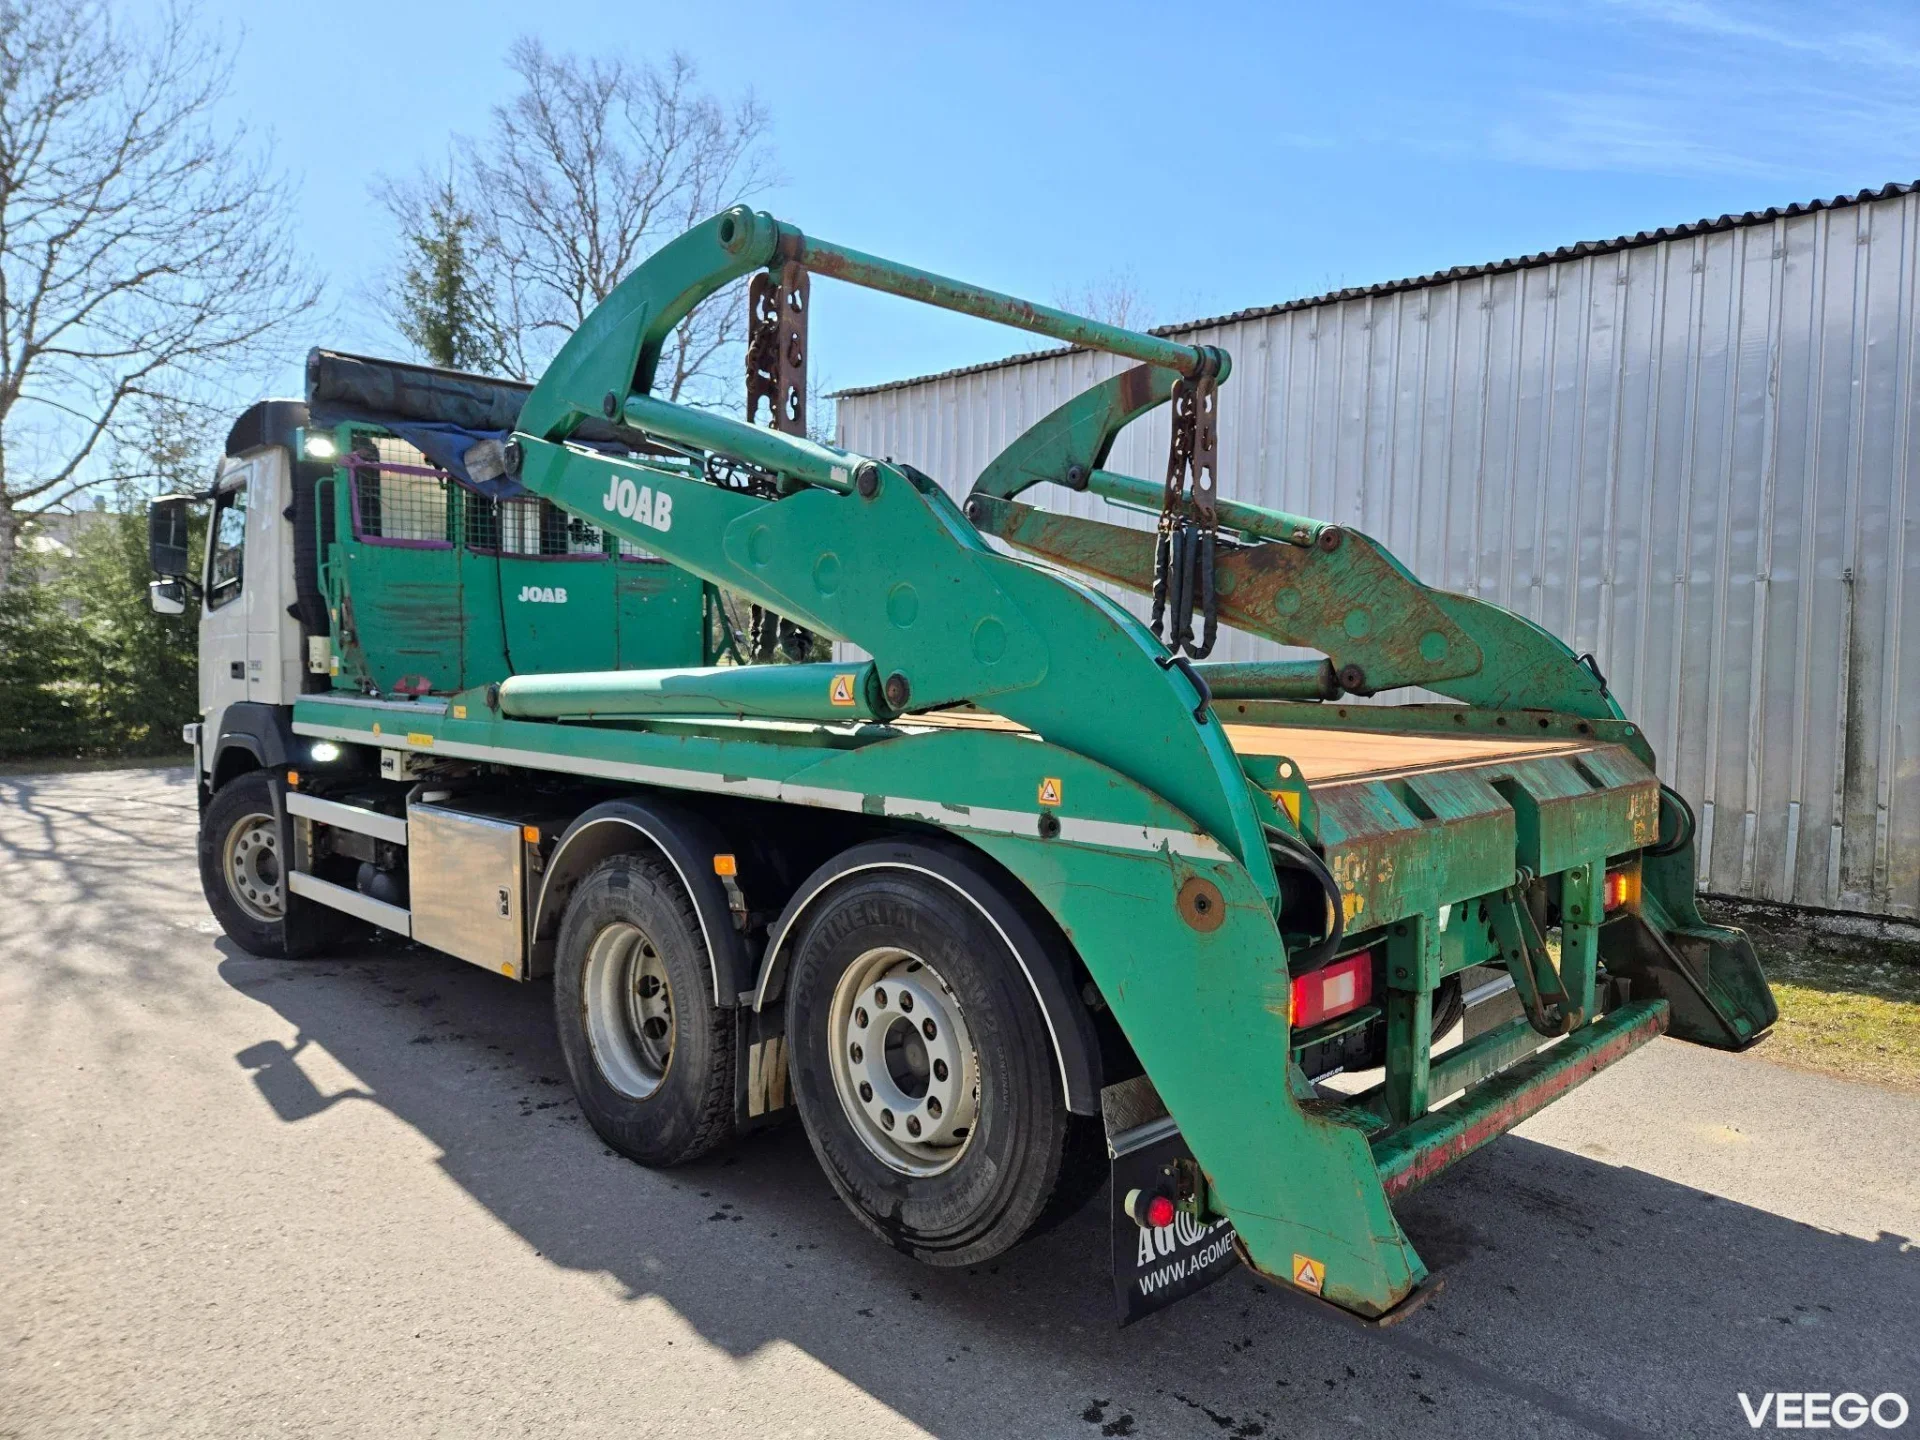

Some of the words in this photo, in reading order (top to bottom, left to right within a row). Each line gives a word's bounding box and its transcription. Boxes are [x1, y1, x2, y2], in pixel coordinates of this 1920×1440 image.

[603, 474, 672, 532] JOAB
[517, 586, 568, 604] JOAB
[796, 899, 922, 1007] CONTINENTAL
